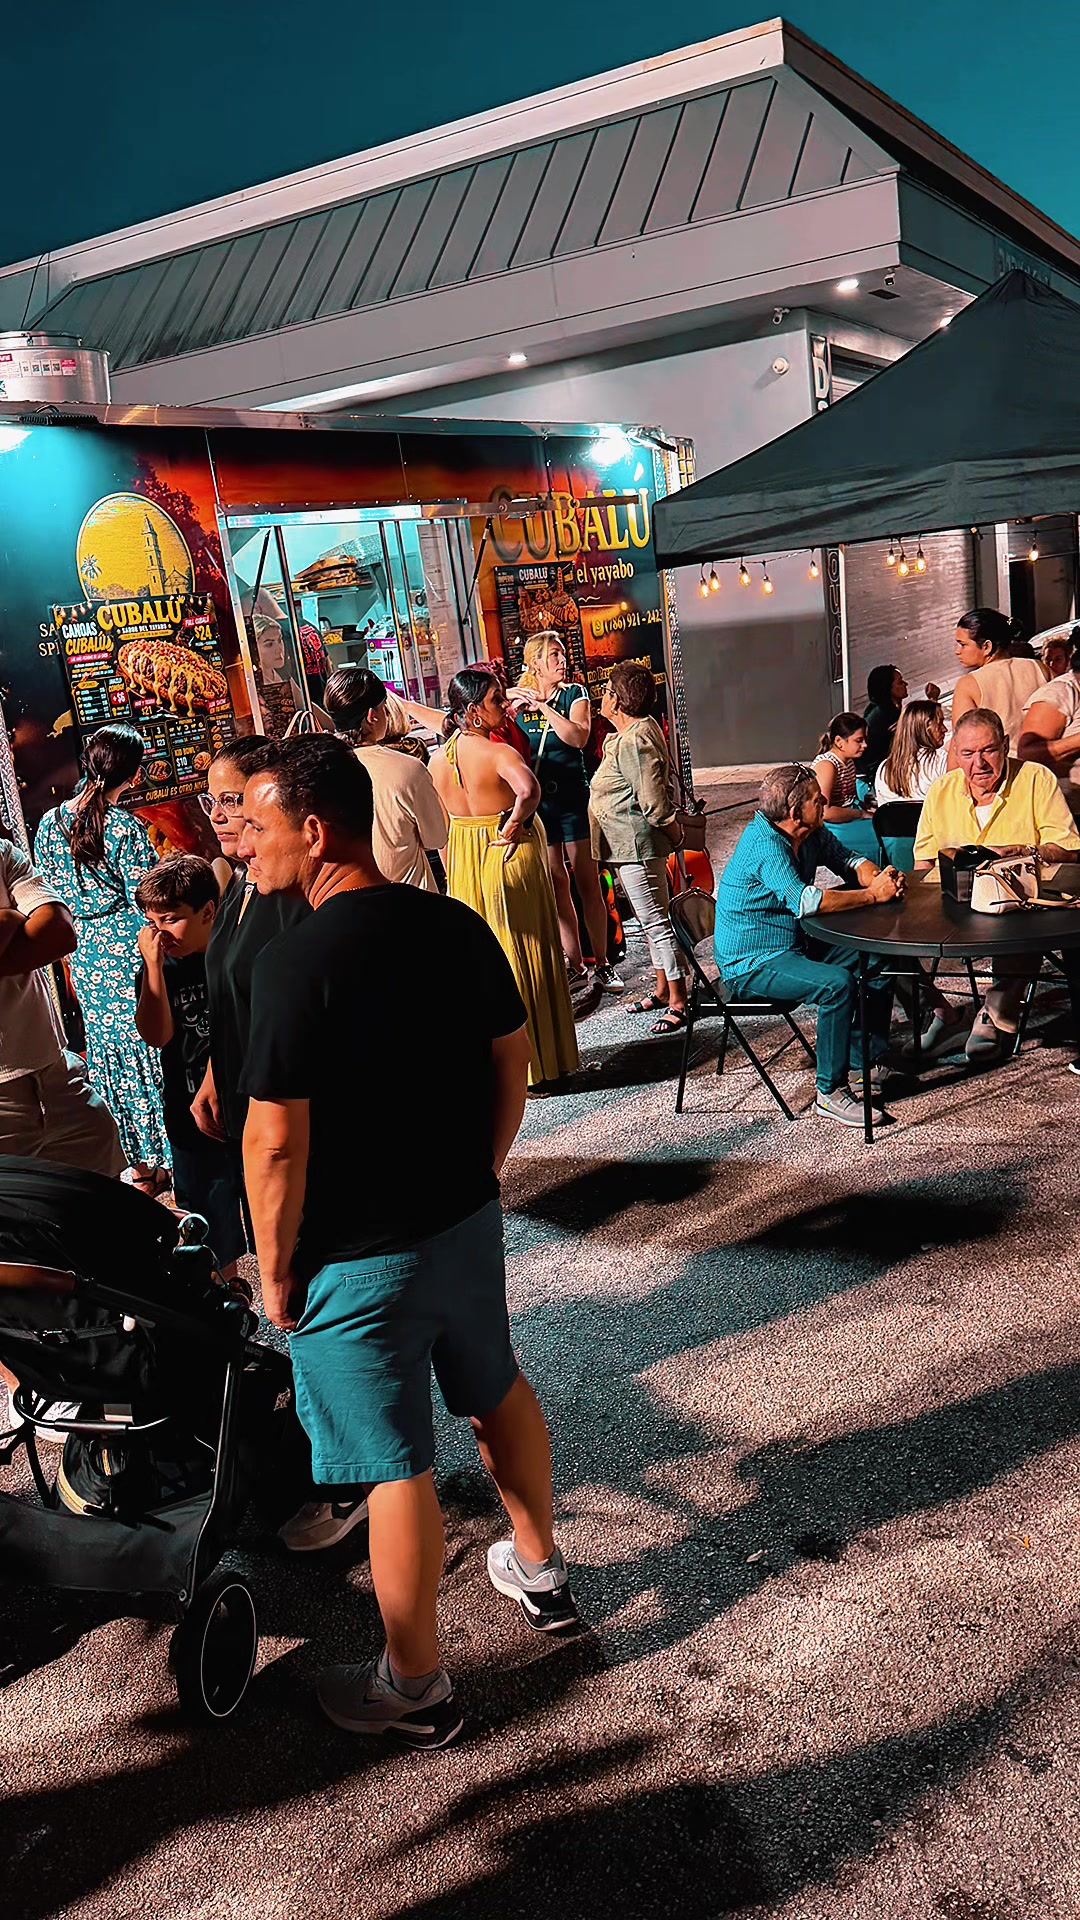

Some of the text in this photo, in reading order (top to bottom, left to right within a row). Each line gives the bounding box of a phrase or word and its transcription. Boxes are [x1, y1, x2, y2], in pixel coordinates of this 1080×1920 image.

[590, 557, 633, 588] yayabo
[96, 596, 182, 631] CUBALÚ
[605, 614, 626, 633] (786)
[627, 612, 641, 628] 921
[62, 621, 98, 639] CANOAS
[194, 624, 212, 641] $24
[145, 785, 169, 802] CUBALÚ
[169, 786, 178, 797] ES
